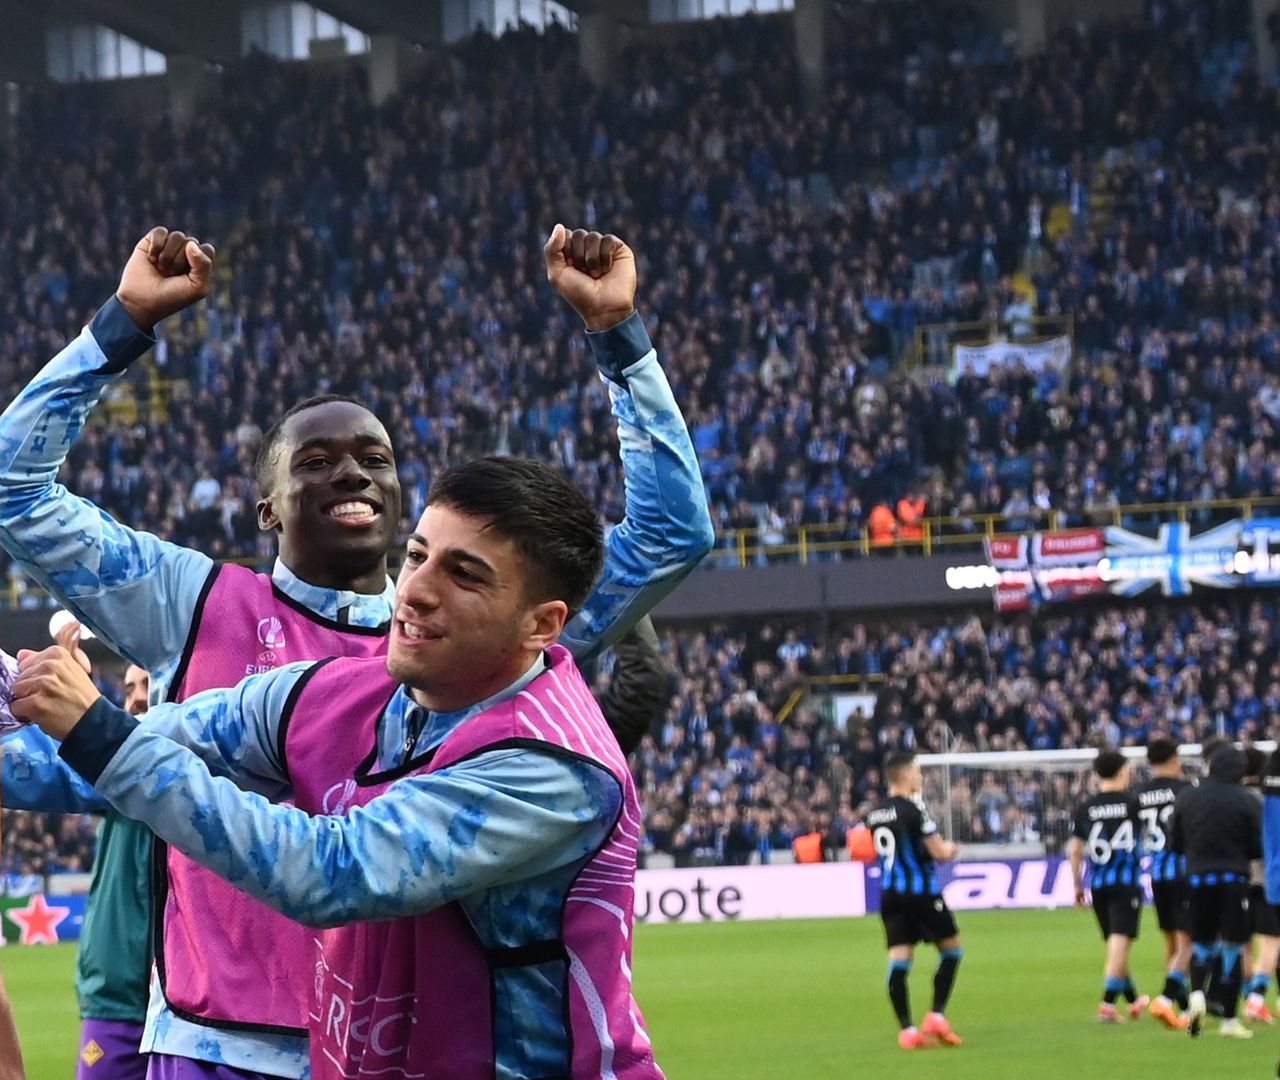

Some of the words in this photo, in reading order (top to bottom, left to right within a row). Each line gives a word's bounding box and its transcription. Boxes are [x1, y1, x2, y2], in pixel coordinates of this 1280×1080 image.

[873, 826, 895, 873] 9
[1089, 819, 1136, 865] 64
[634, 877, 744, 921] uote
